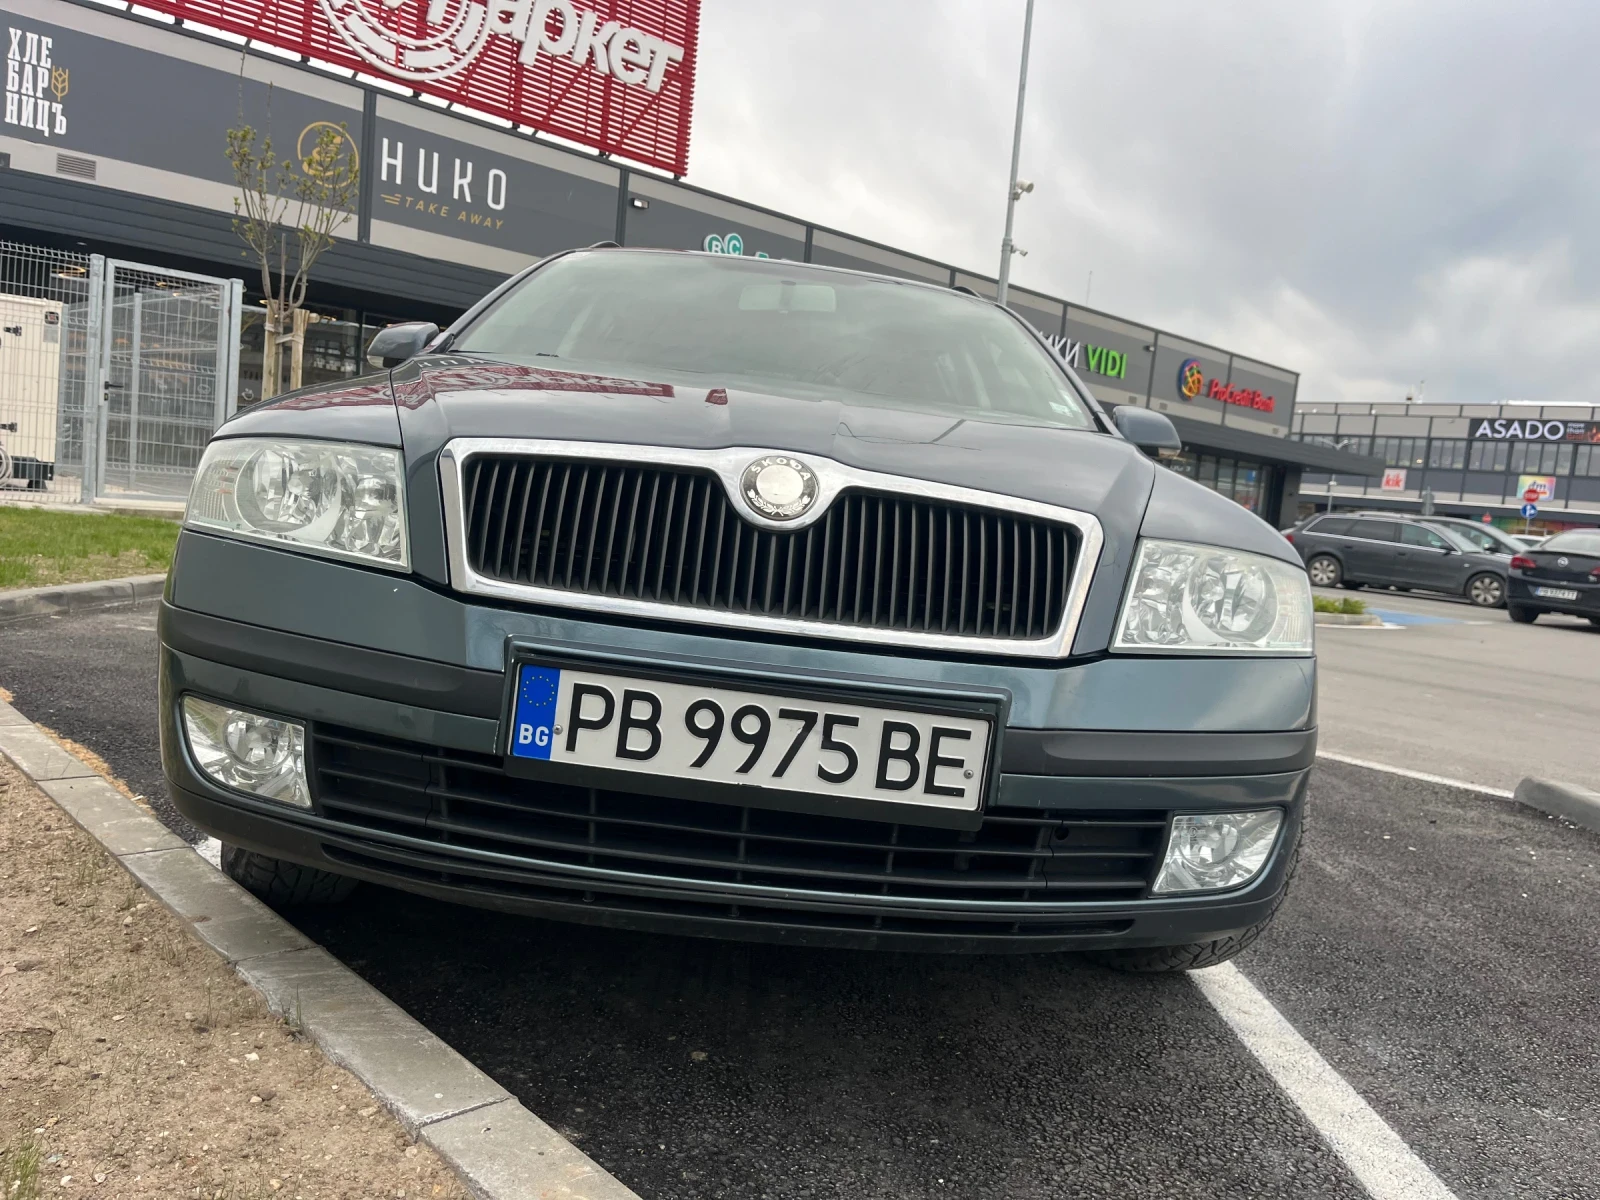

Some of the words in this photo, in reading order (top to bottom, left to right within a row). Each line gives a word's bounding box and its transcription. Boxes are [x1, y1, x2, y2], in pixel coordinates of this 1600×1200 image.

[7, 27, 53, 69] ХЛЕ
[6, 59, 50, 98] БАР
[4, 91, 67, 137] НИЦЪ
[405, 196, 449, 217] TAKE
[457, 210, 504, 230] AWAY
[1087, 344, 1128, 379] VIDI
[1209, 378, 1252, 407] ProCredit
[1252, 390, 1276, 413] Bank
[1475, 419, 1565, 440] ASADO
[518, 723, 550, 748] BG
[564, 682, 664, 761] PB
[684, 698, 860, 784] 9975
[875, 719, 972, 798] BE
